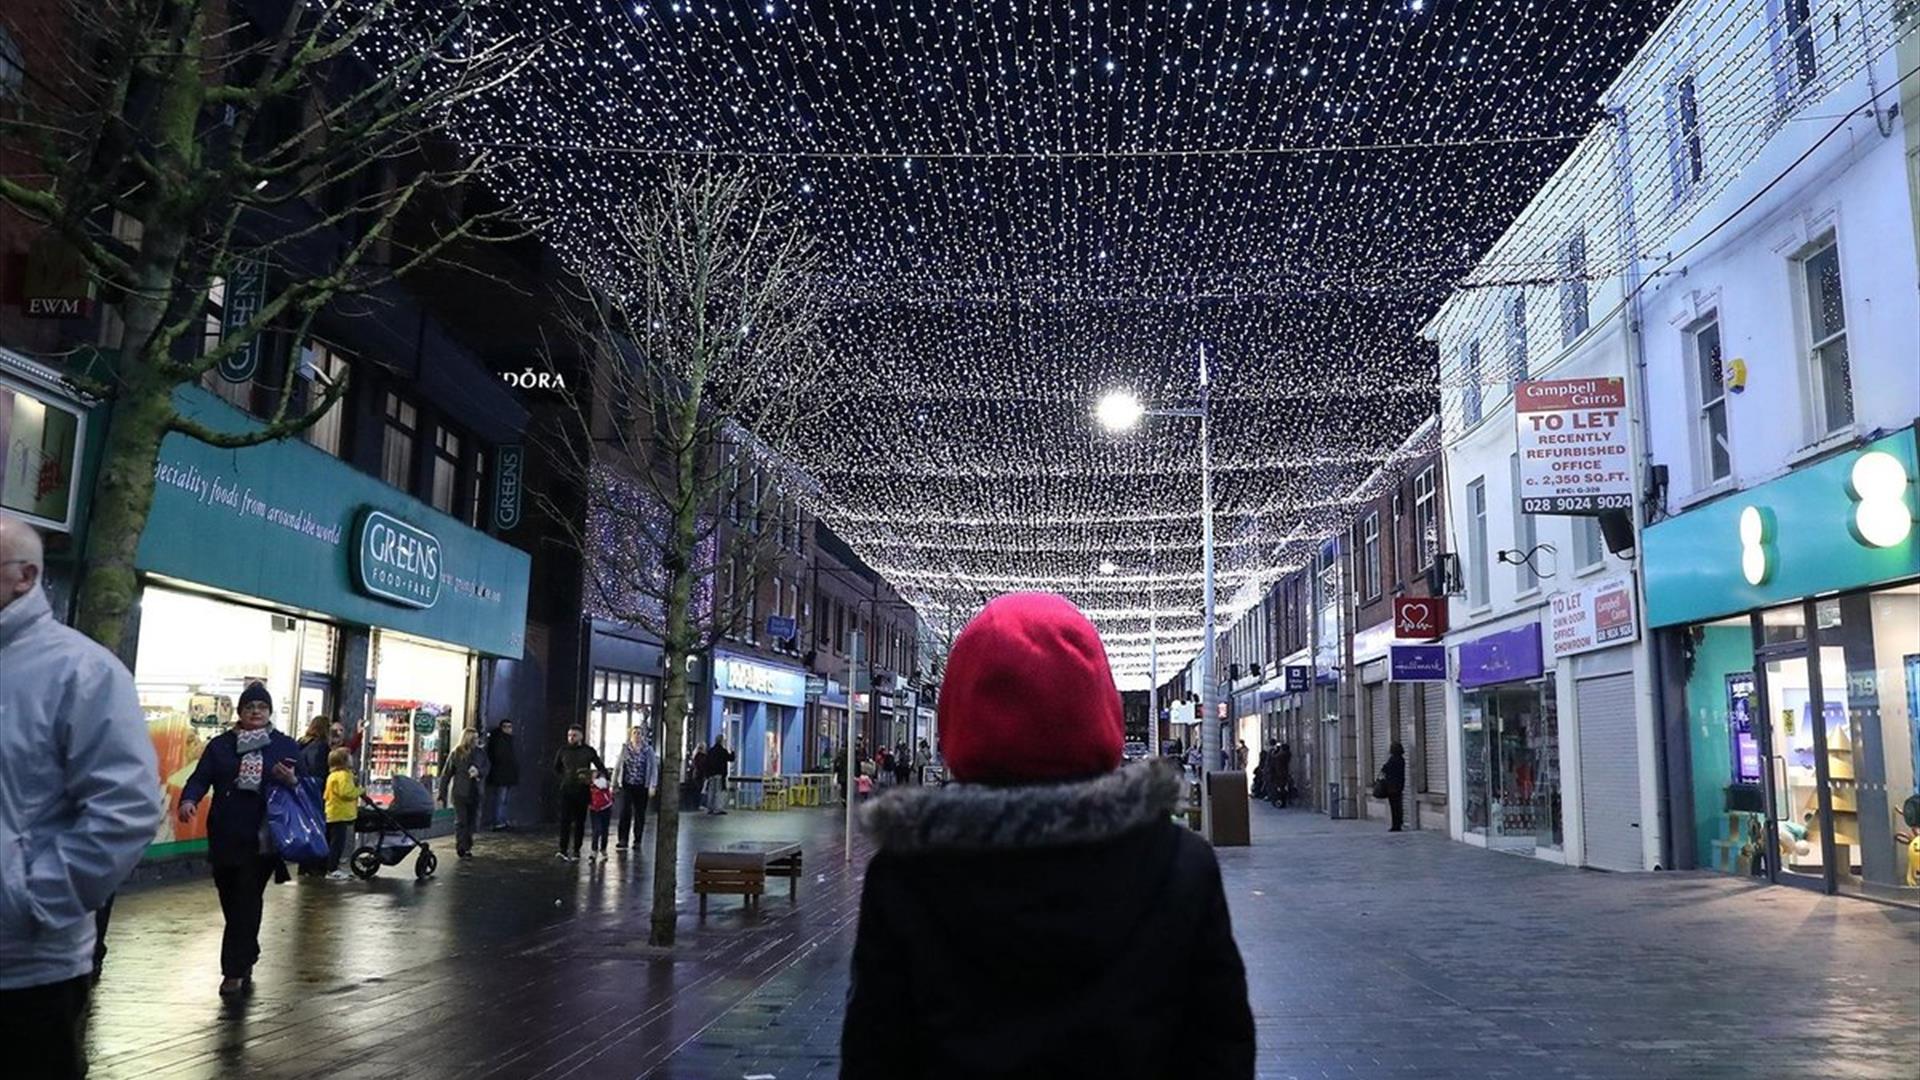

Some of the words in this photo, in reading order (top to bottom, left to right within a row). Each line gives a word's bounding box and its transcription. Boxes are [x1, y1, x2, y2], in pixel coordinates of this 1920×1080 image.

[29, 298, 80, 314] EWM
[1526, 381, 1596, 398] Campbell
[1571, 393, 1618, 406] Cairns
[1528, 414, 1563, 431] TO
[1572, 411, 1619, 429] LET
[1538, 432, 1611, 444] RECENTLY
[1527, 445, 1626, 459] REFURBISHED
[1551, 460, 1602, 471] OFFICE
[500, 452, 518, 522] GREENS
[1542, 474, 1580, 486] 2,350
[207, 476, 240, 508] foods
[238, 488, 266, 517] from
[266, 509, 304, 531] around
[301, 516, 316, 536] the
[315, 524, 342, 545] world
[1524, 499, 1551, 512] 028
[1556, 498, 1592, 511] 9024
[1597, 495, 1632, 509] 9024
[369, 523, 438, 580] GREENS
[1552, 598, 1565, 614] TO
[1566, 592, 1582, 611] LET
[1553, 626, 1576, 641] OFFICE
